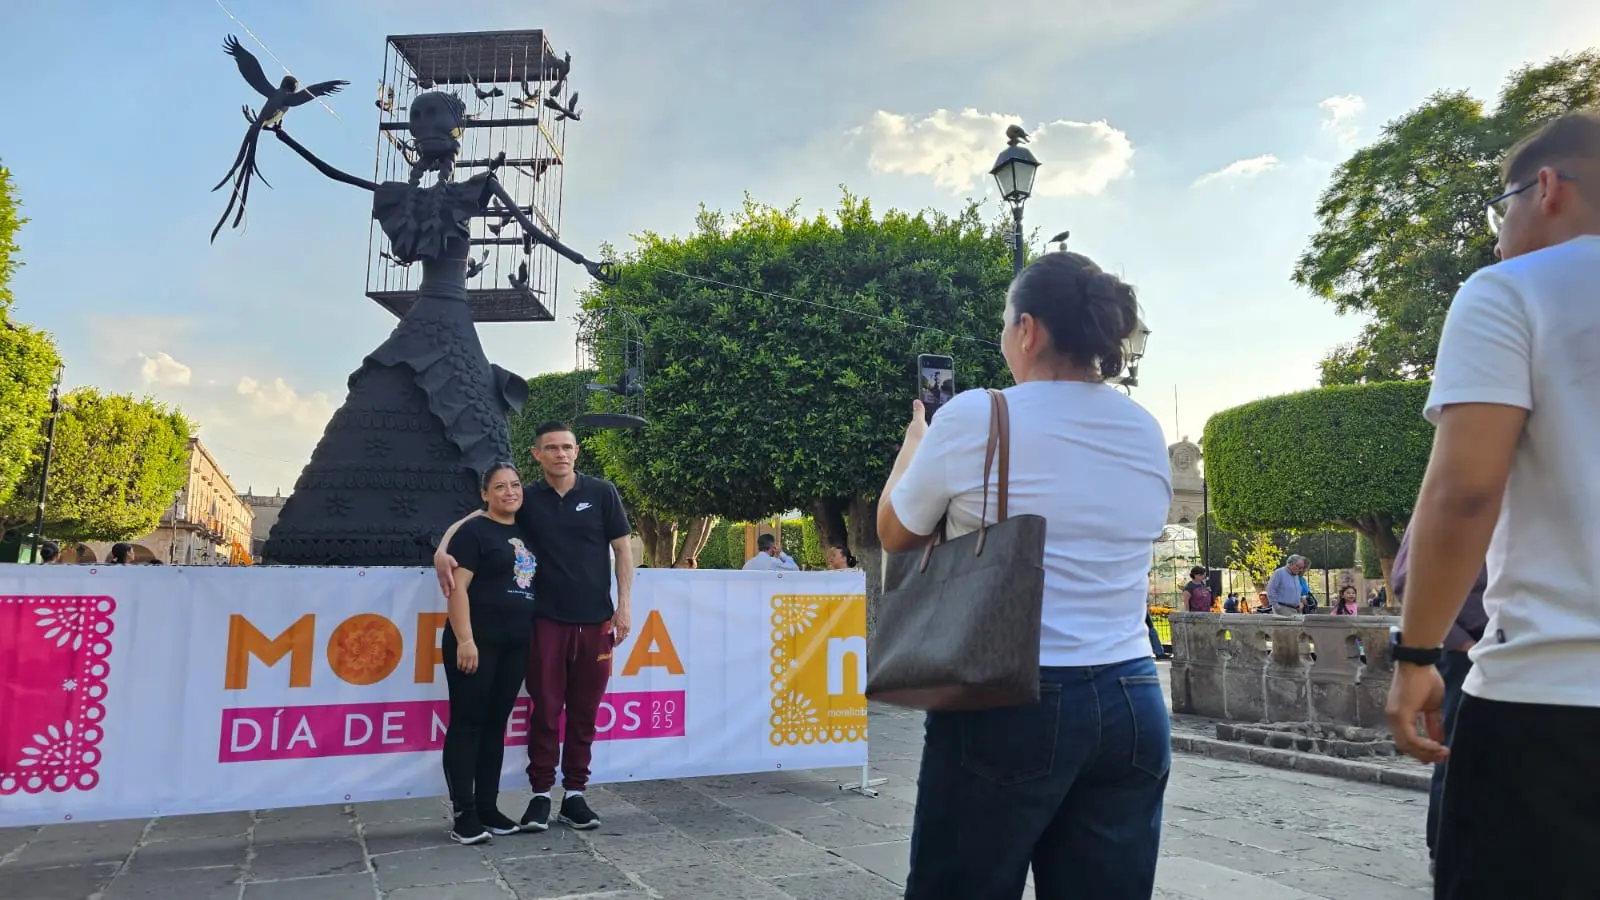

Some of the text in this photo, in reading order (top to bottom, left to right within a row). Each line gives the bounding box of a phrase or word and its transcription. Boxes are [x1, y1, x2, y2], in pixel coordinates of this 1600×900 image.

[652, 700, 675, 714] 20
[652, 715, 673, 728] 25
[230, 709, 317, 752] DÍA
[344, 711, 406, 746] DE
